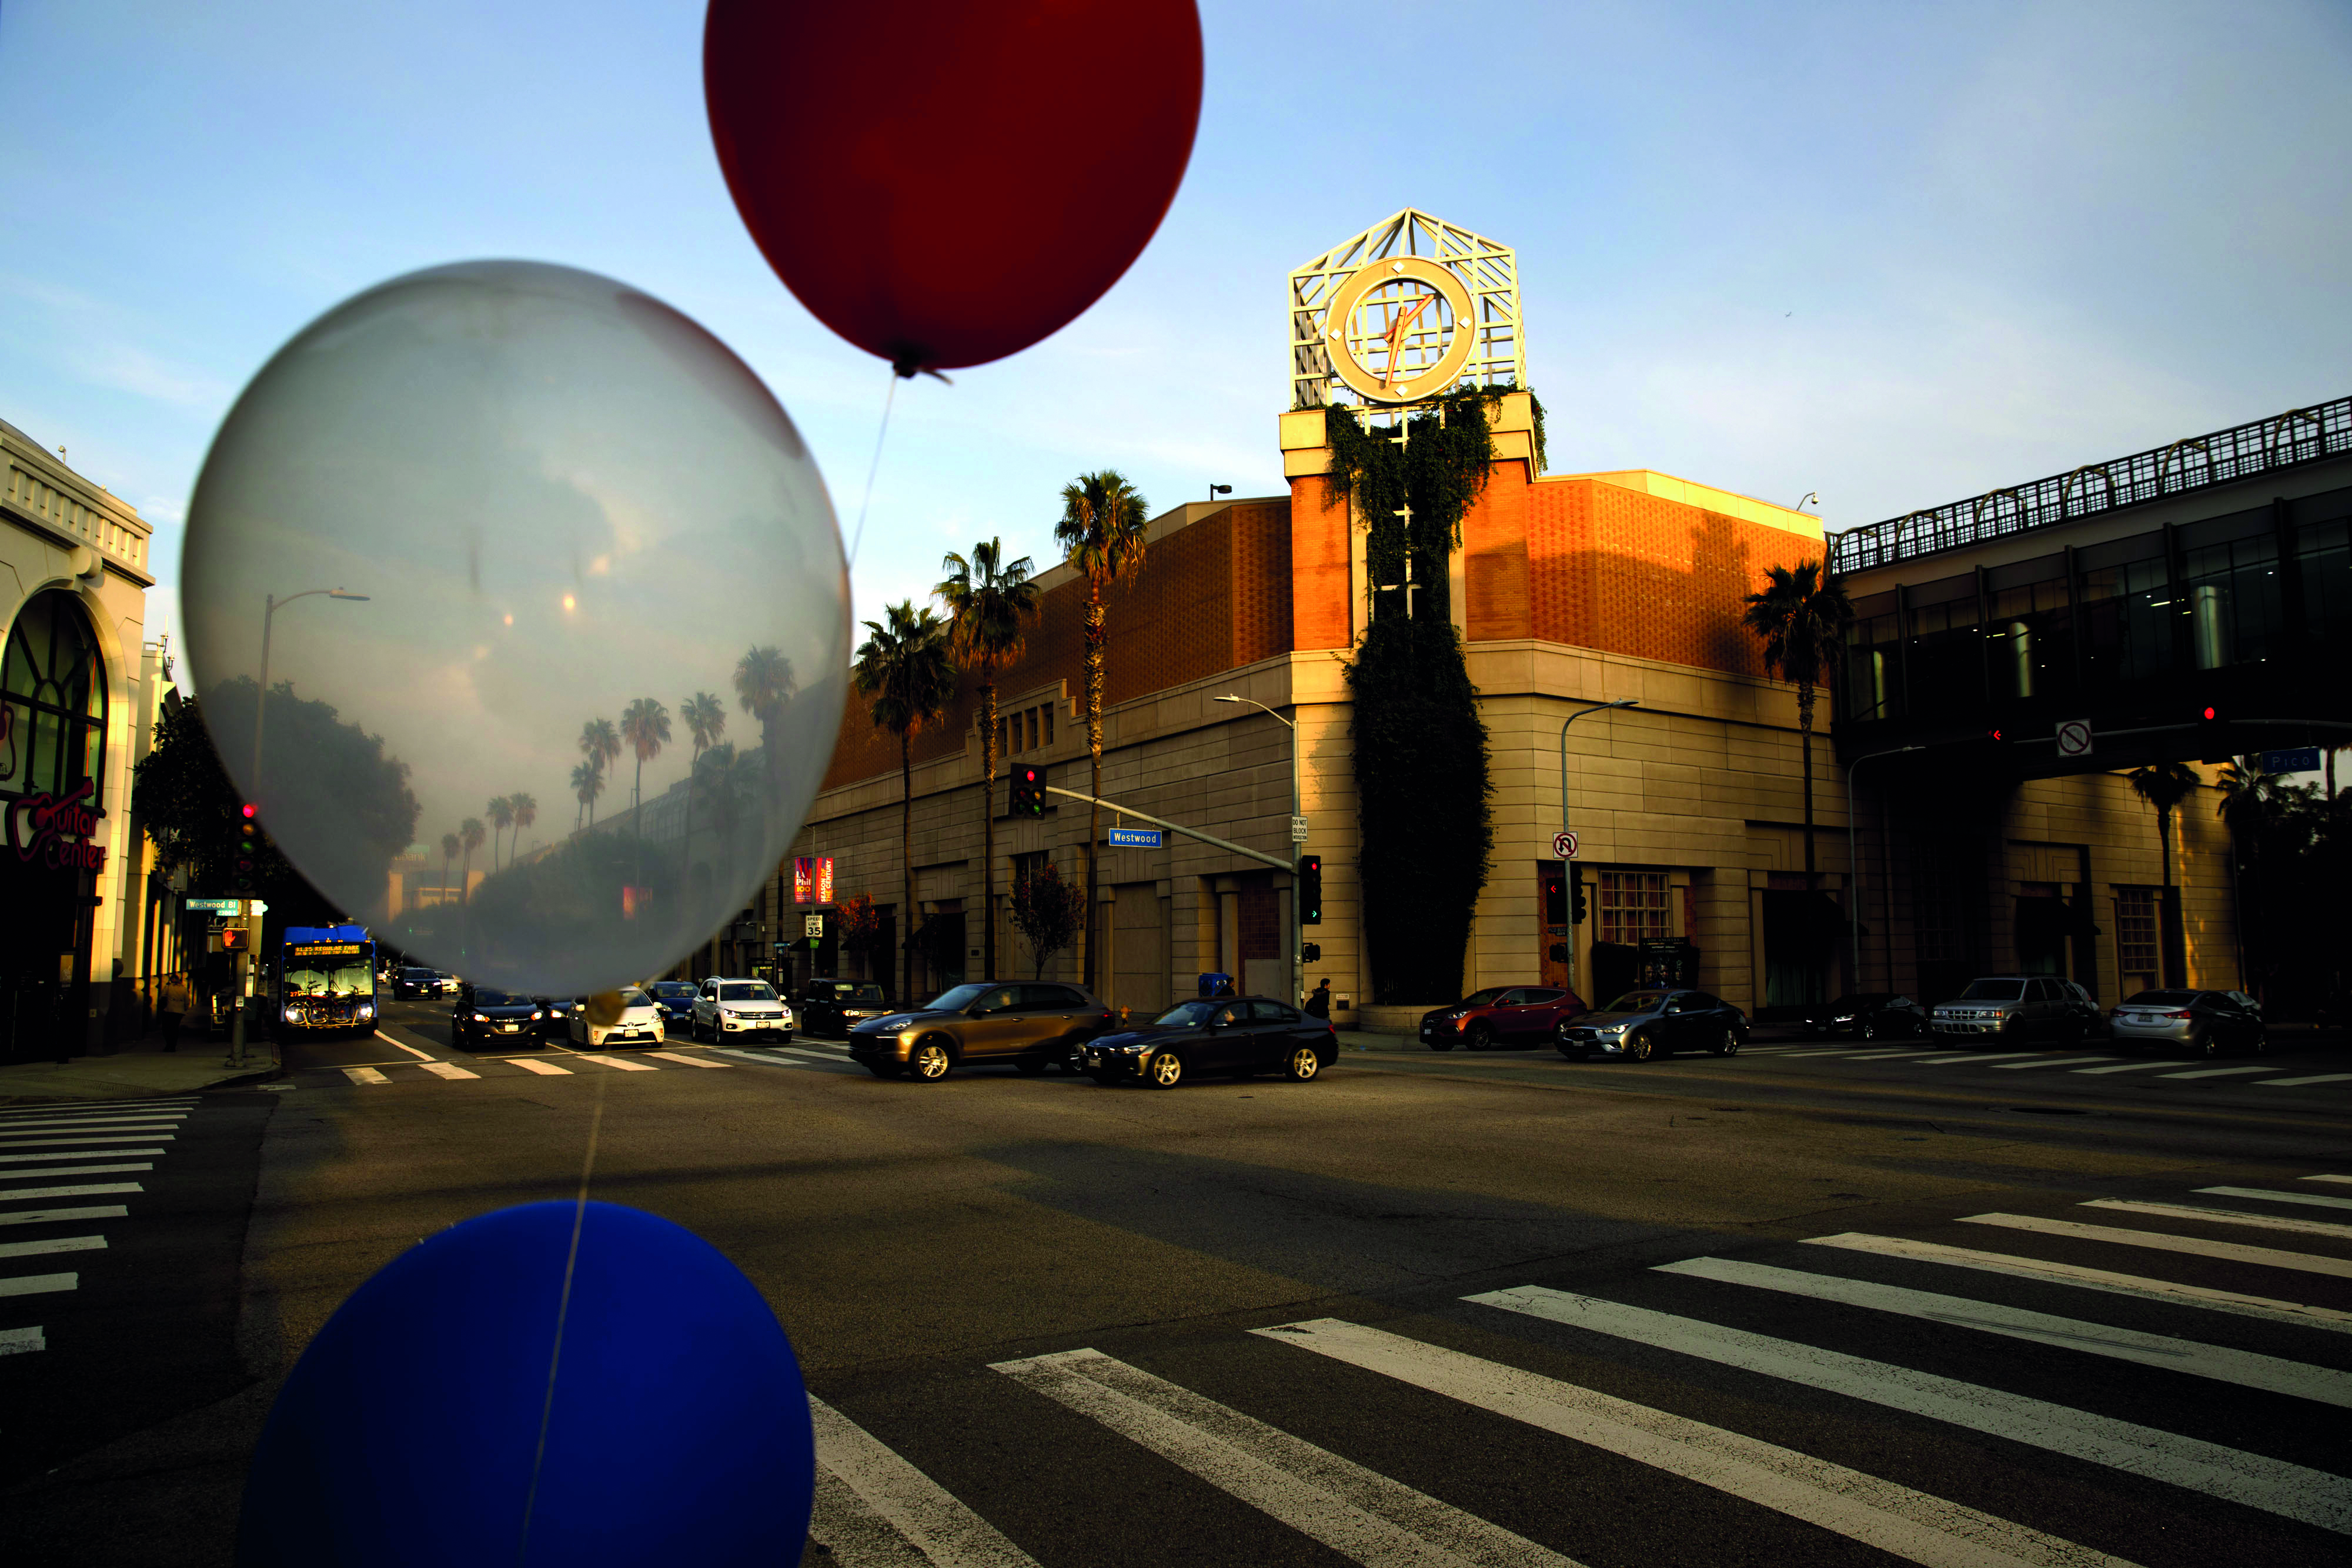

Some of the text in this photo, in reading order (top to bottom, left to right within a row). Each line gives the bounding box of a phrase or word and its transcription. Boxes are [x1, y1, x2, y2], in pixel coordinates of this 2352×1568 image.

[1114, 833, 1156, 843] Westwood
[45, 834, 106, 871] Center
[820, 868, 826, 877] OF
[807, 927, 821, 935] 35
